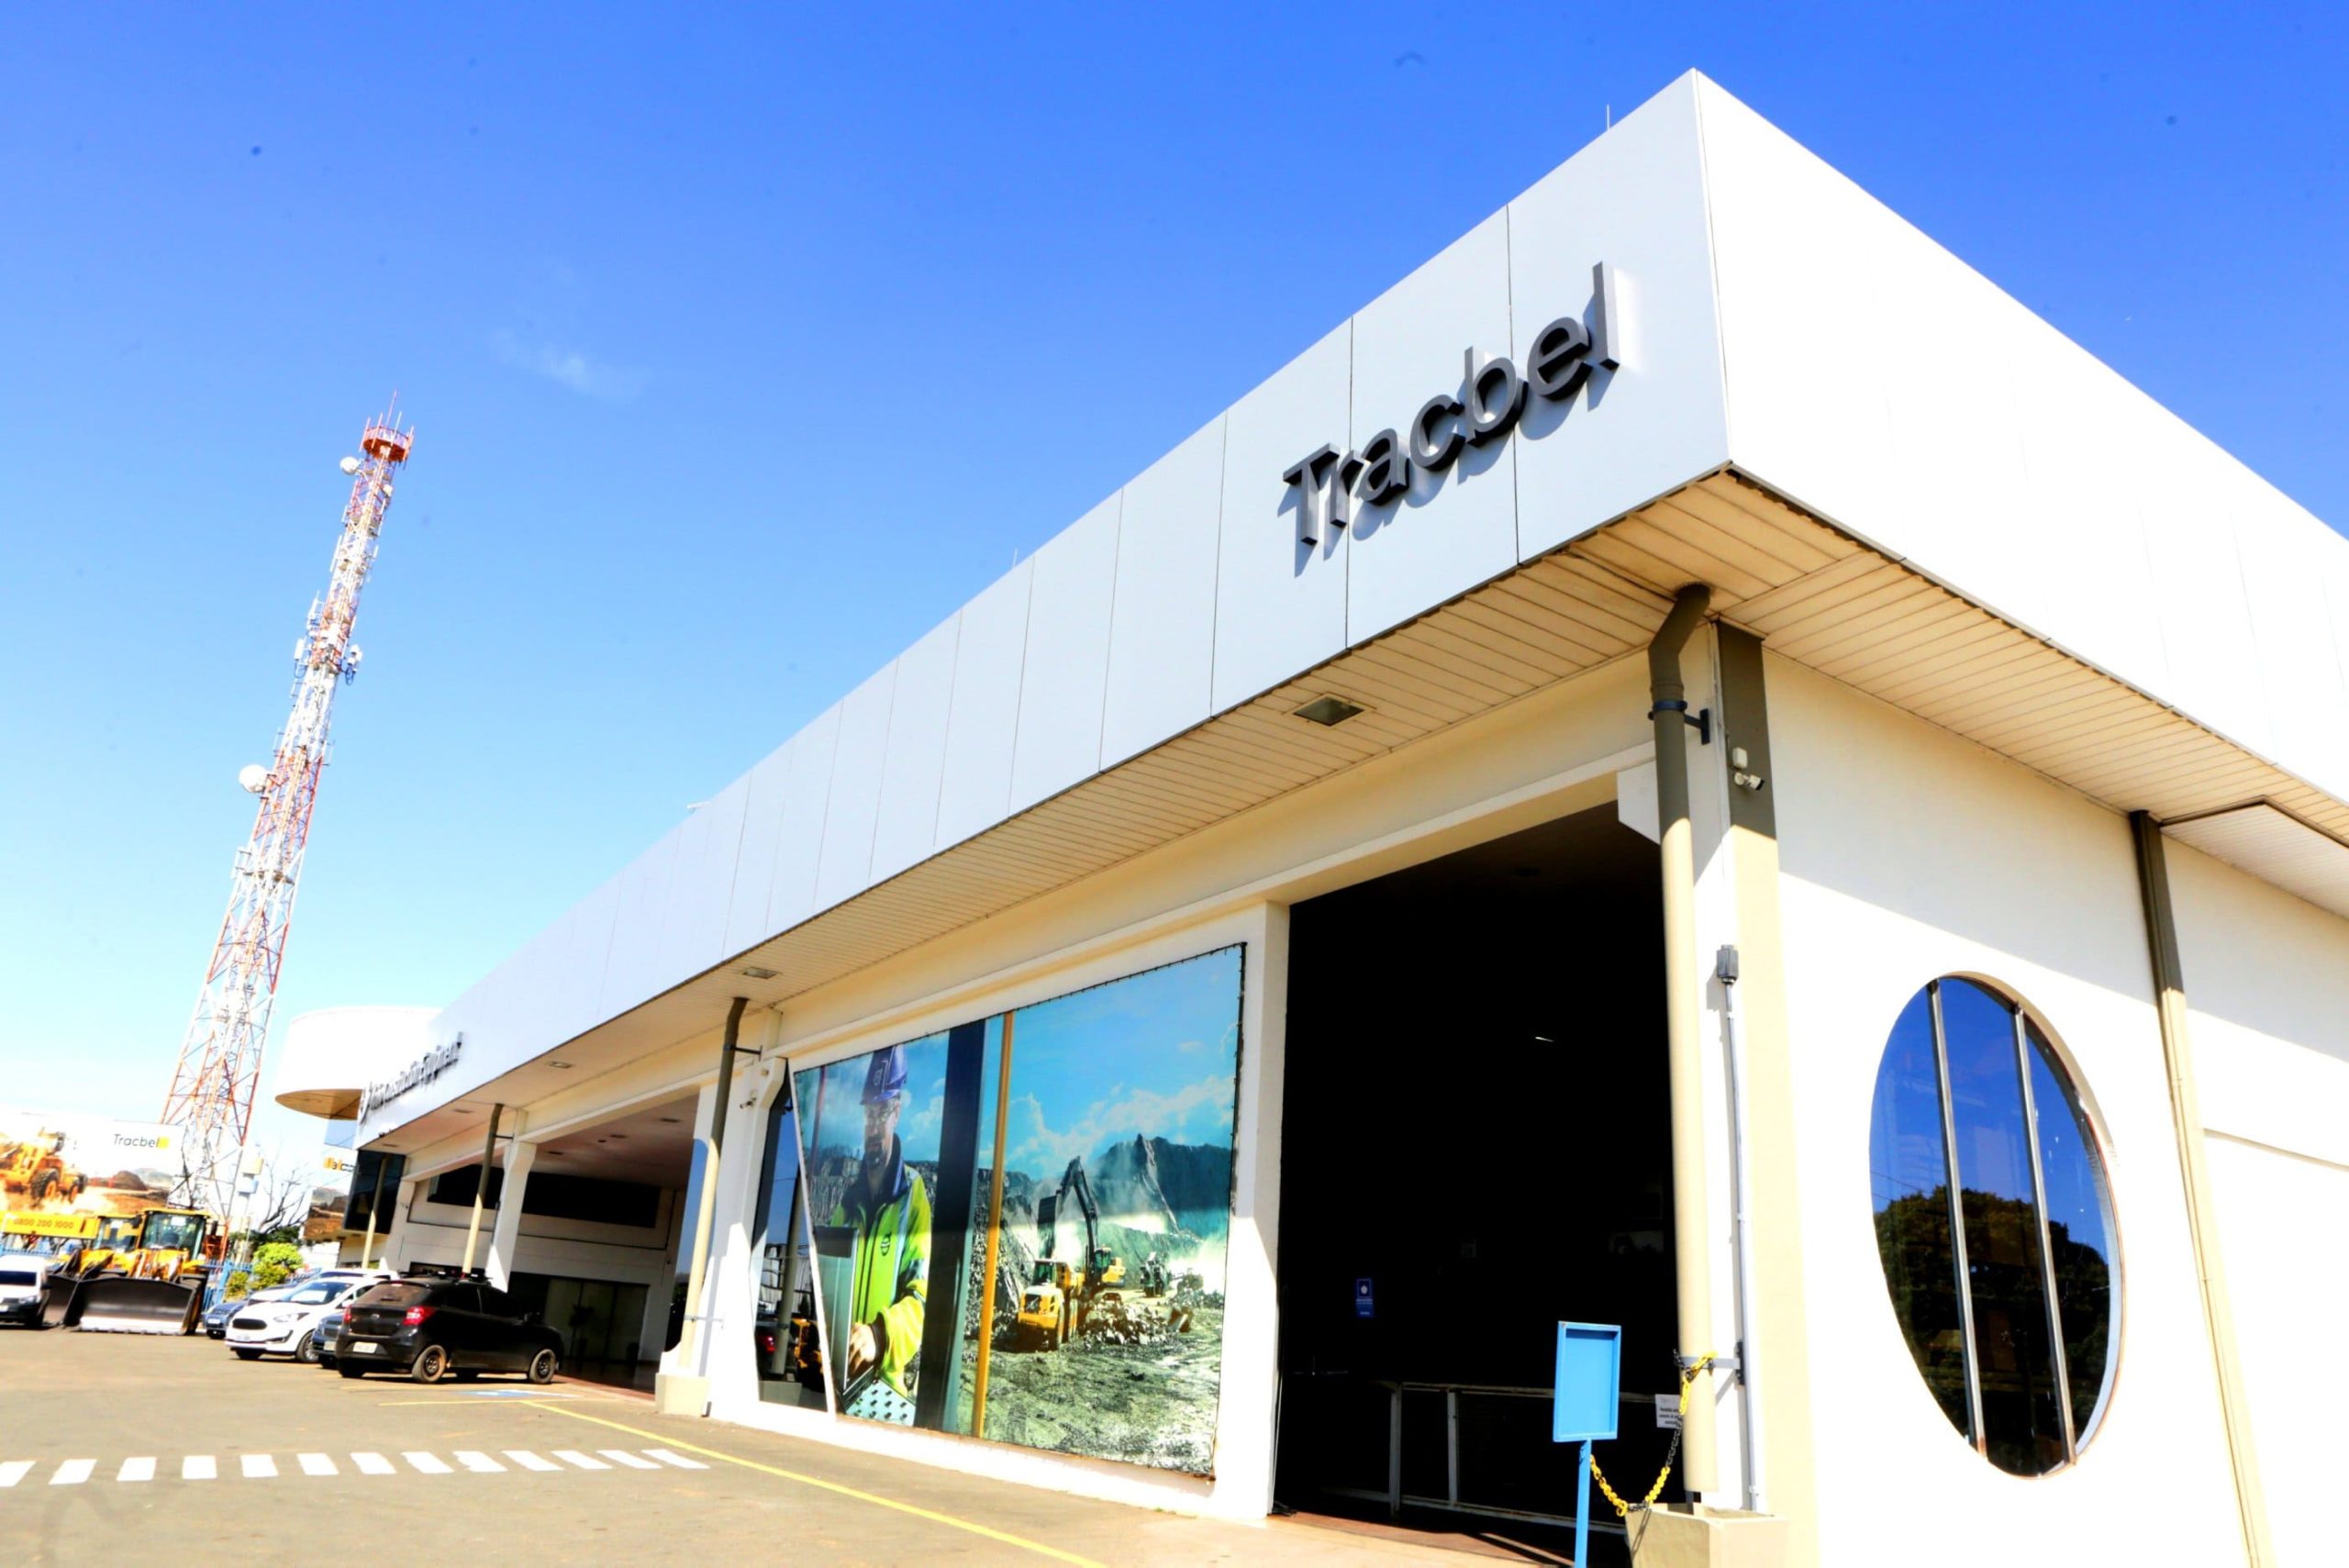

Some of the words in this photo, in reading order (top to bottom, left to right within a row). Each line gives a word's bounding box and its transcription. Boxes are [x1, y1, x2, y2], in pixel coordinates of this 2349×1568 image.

[1282, 261, 1620, 546] Tracbel
[113, 1133, 161, 1148] Tracbel
[13, 1218, 36, 1227] 0800
